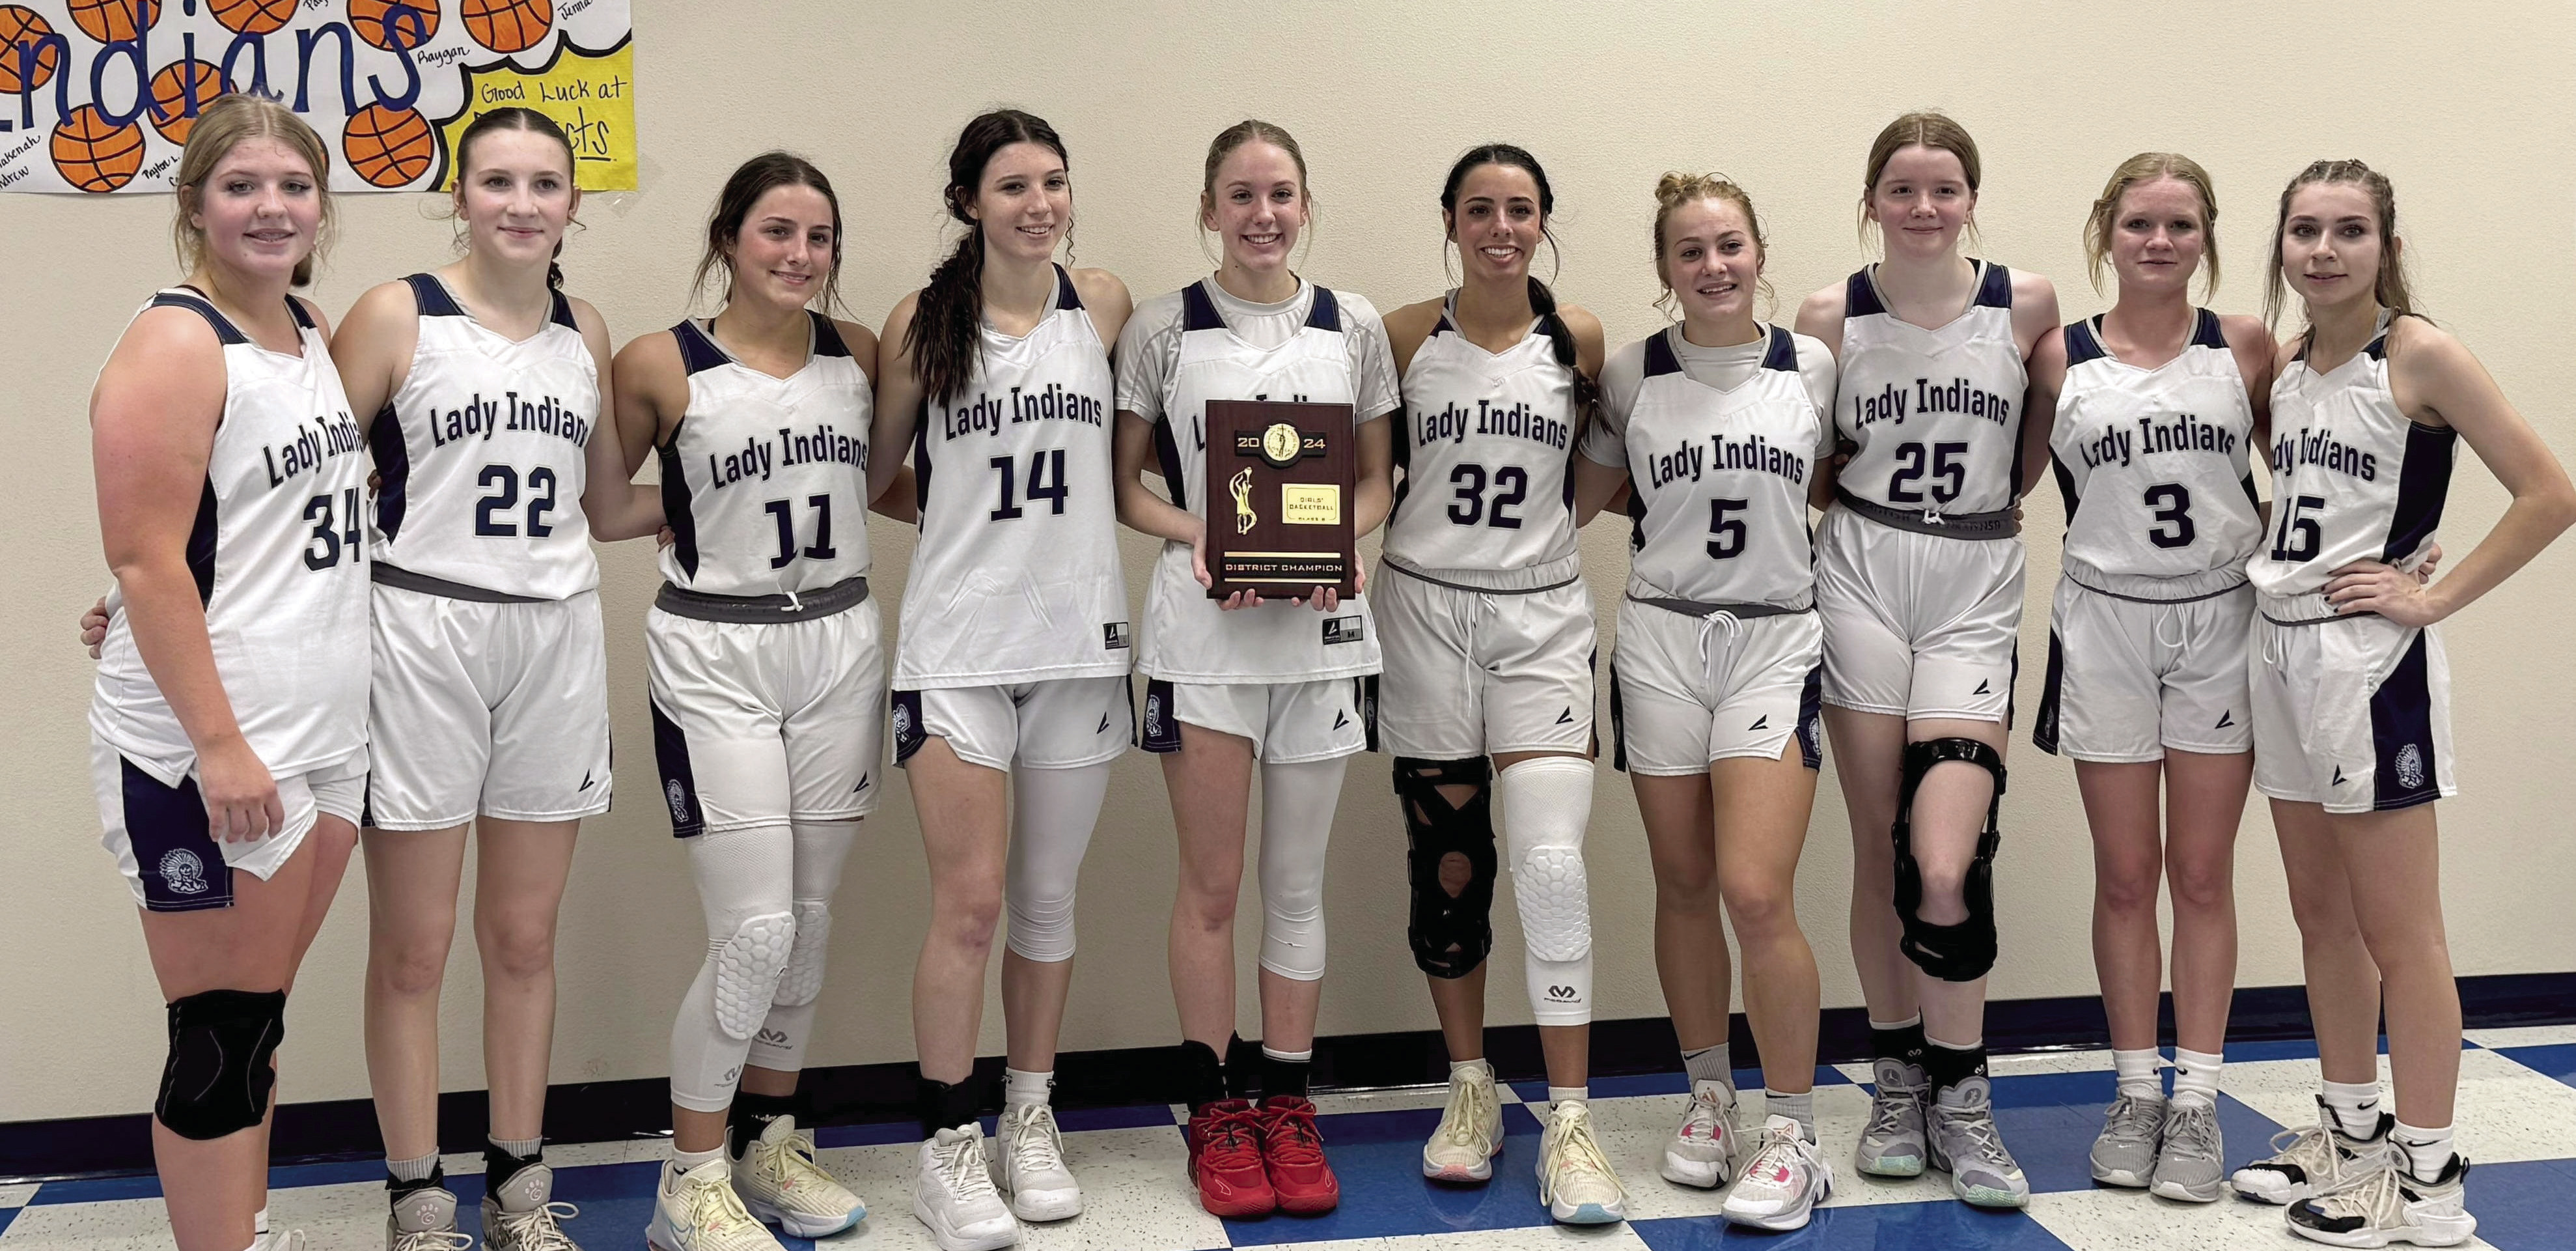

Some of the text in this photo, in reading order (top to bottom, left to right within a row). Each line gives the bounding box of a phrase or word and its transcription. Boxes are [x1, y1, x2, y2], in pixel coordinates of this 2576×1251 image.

[0, 0, 422, 132] ndians
[417, 46, 470, 68] Raygan
[482, 74, 628, 104] Good Luck at
[430, 391, 589, 450] Lady Indian
[945, 383, 1101, 442] Lady Indians
[1417, 399, 1568, 451] Lady Indians
[1855, 378, 2010, 432] Lady Indians
[263, 412, 364, 489] Lady Indi
[710, 425, 868, 490] Lady Indians
[1237, 437, 1326, 449] 20 24
[1649, 434, 1804, 490] Lady Indians
[1888, 442, 1969, 505] 25
[2270, 432, 2295, 477] dy
[475, 464, 556, 538] 22
[989, 449, 1069, 522] 14
[1447, 464, 1528, 529] 32
[2143, 483, 2196, 549] 3
[303, 487, 361, 572] 34
[764, 493, 837, 570] 11
[1706, 498, 1749, 560] 5
[2271, 495, 2325, 563] 15
[1225, 563, 1277, 572] DISTRICT
